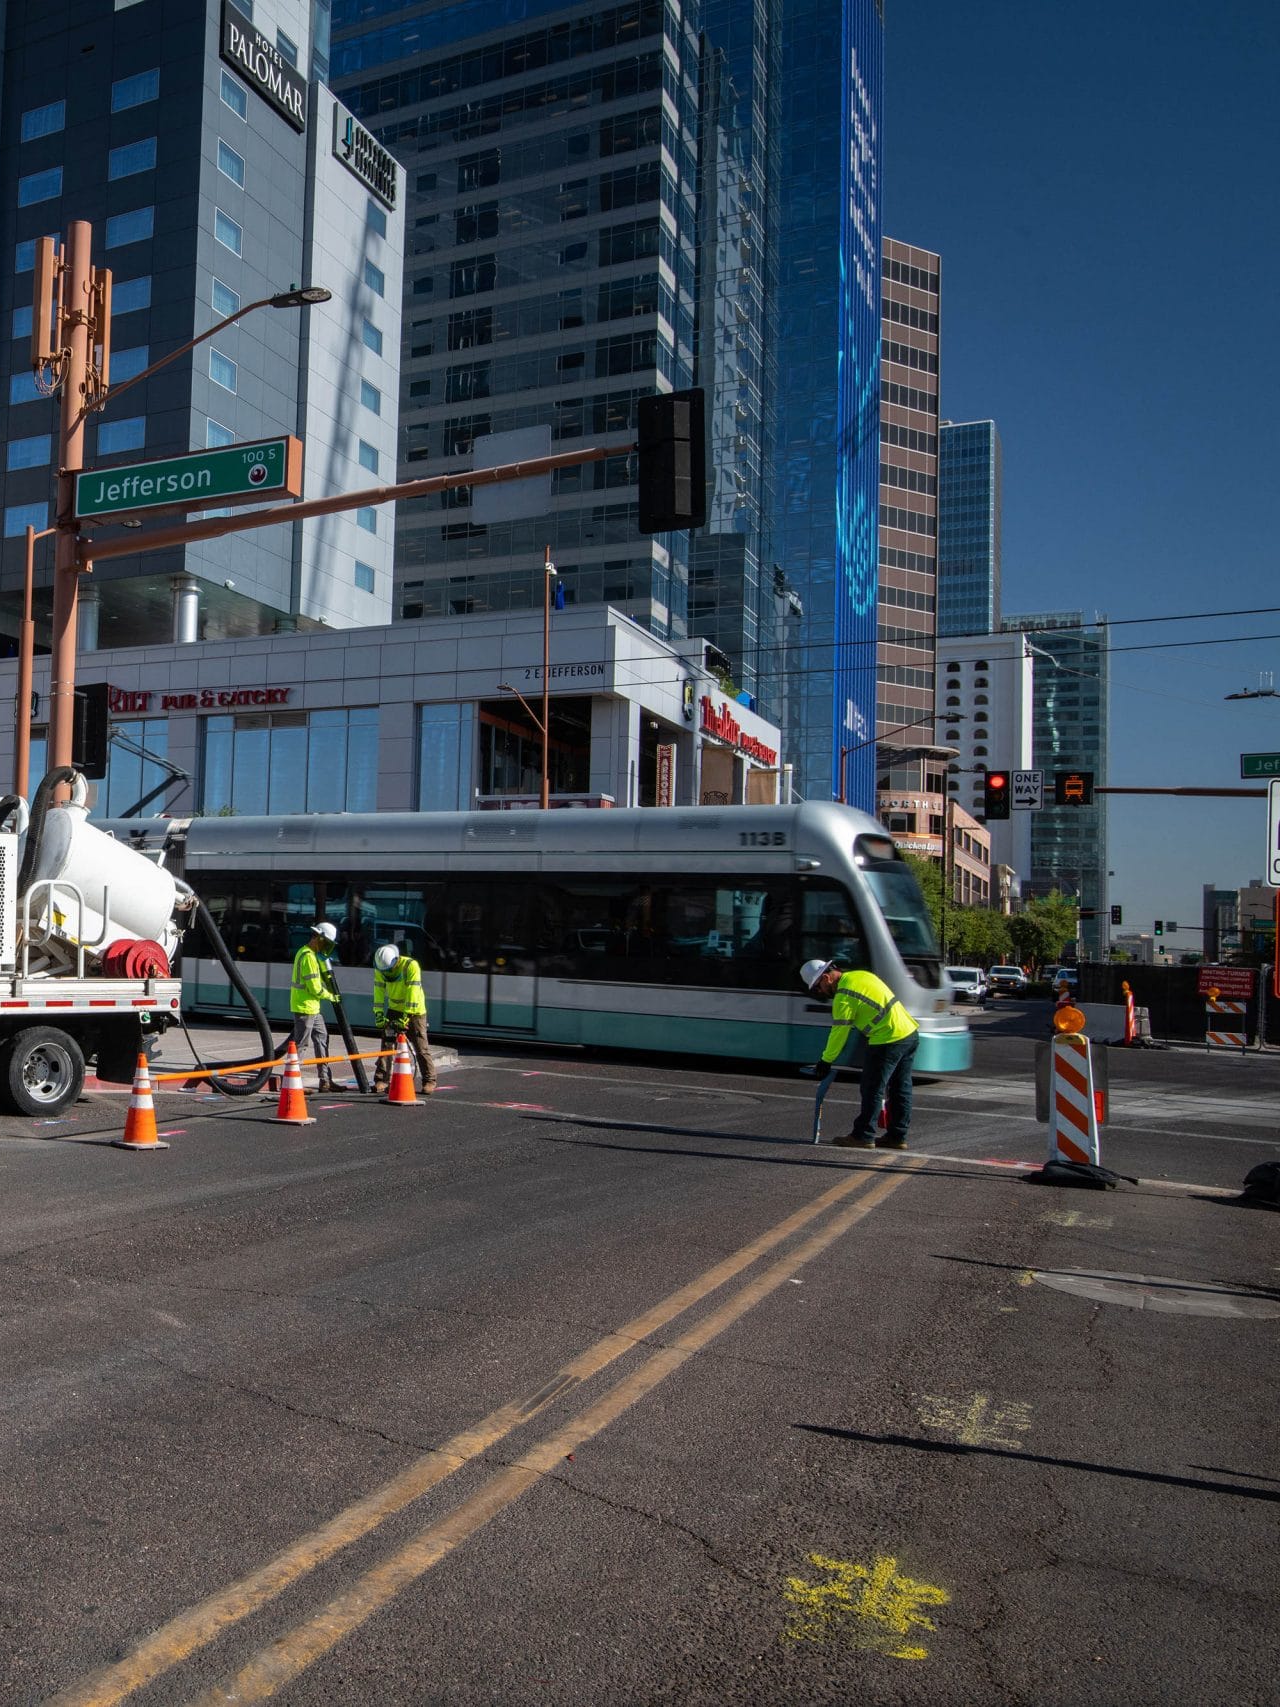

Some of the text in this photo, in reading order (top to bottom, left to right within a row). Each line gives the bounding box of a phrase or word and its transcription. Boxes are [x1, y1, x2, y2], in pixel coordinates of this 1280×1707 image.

[255, 32, 284, 69] HOTEL
[228, 22, 305, 123] PALOMAR
[242, 448, 276, 464] 100 S
[94, 468, 211, 504] Jefferson
[525, 669, 531, 679] 2
[547, 664, 604, 679] JEFFERSON
[1015, 774, 1039, 783] ONE
[1014, 785, 1040, 794] WAY
